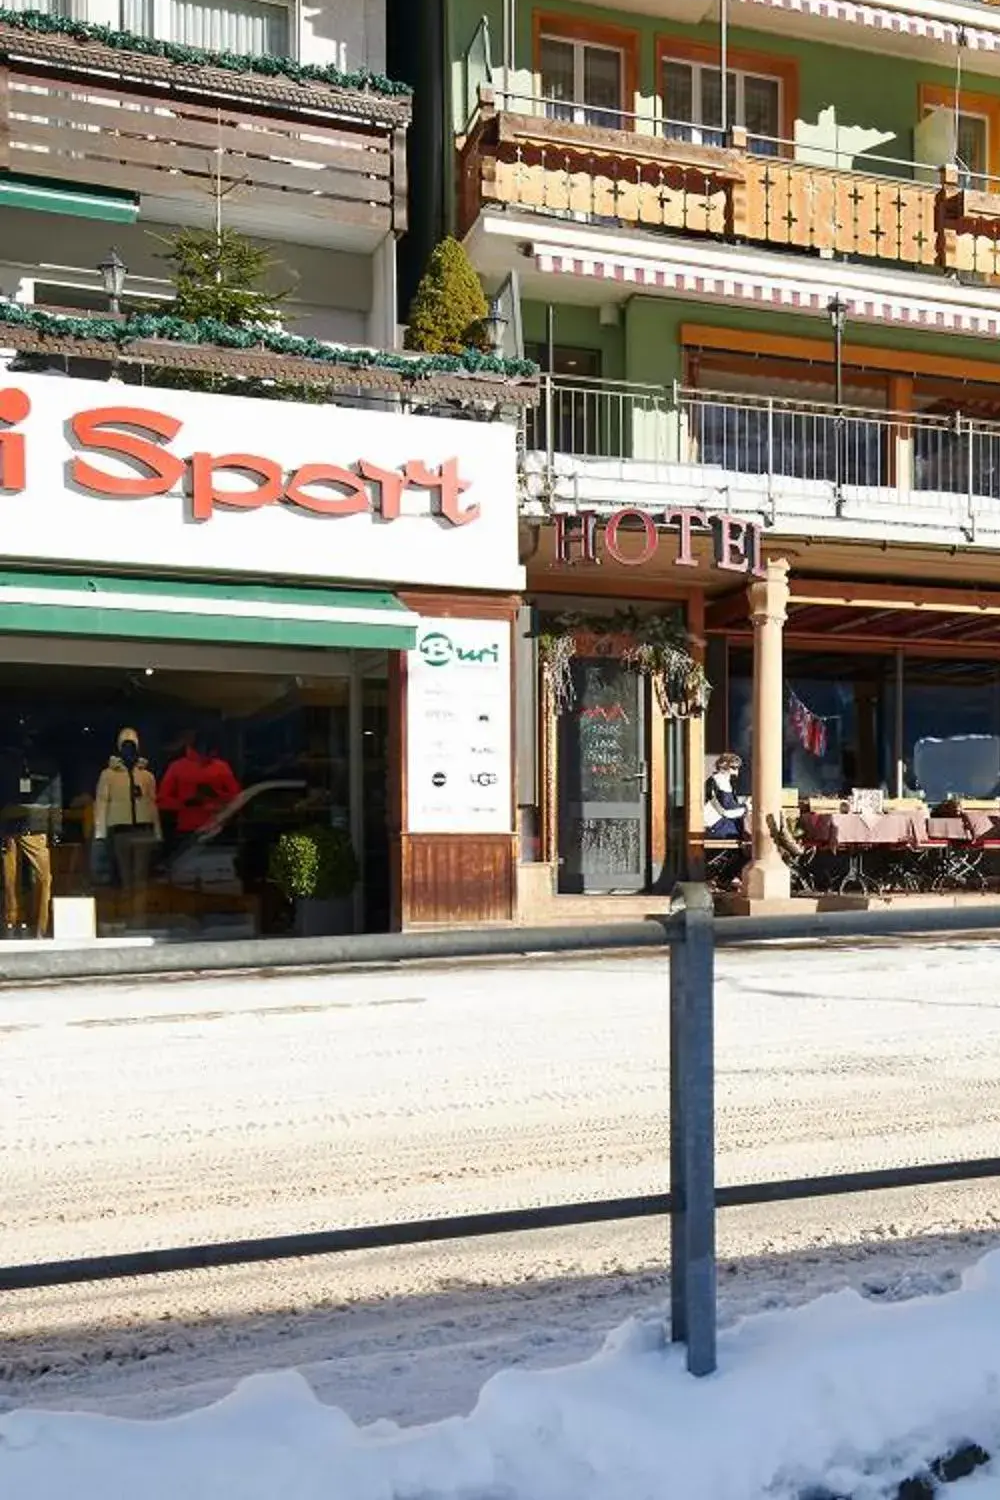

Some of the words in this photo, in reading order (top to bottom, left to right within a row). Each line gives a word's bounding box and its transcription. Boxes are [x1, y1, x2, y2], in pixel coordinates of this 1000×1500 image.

[70, 406, 481, 527] Sport
[551, 505, 768, 579] HOTEL
[420, 632, 499, 667] Buri
